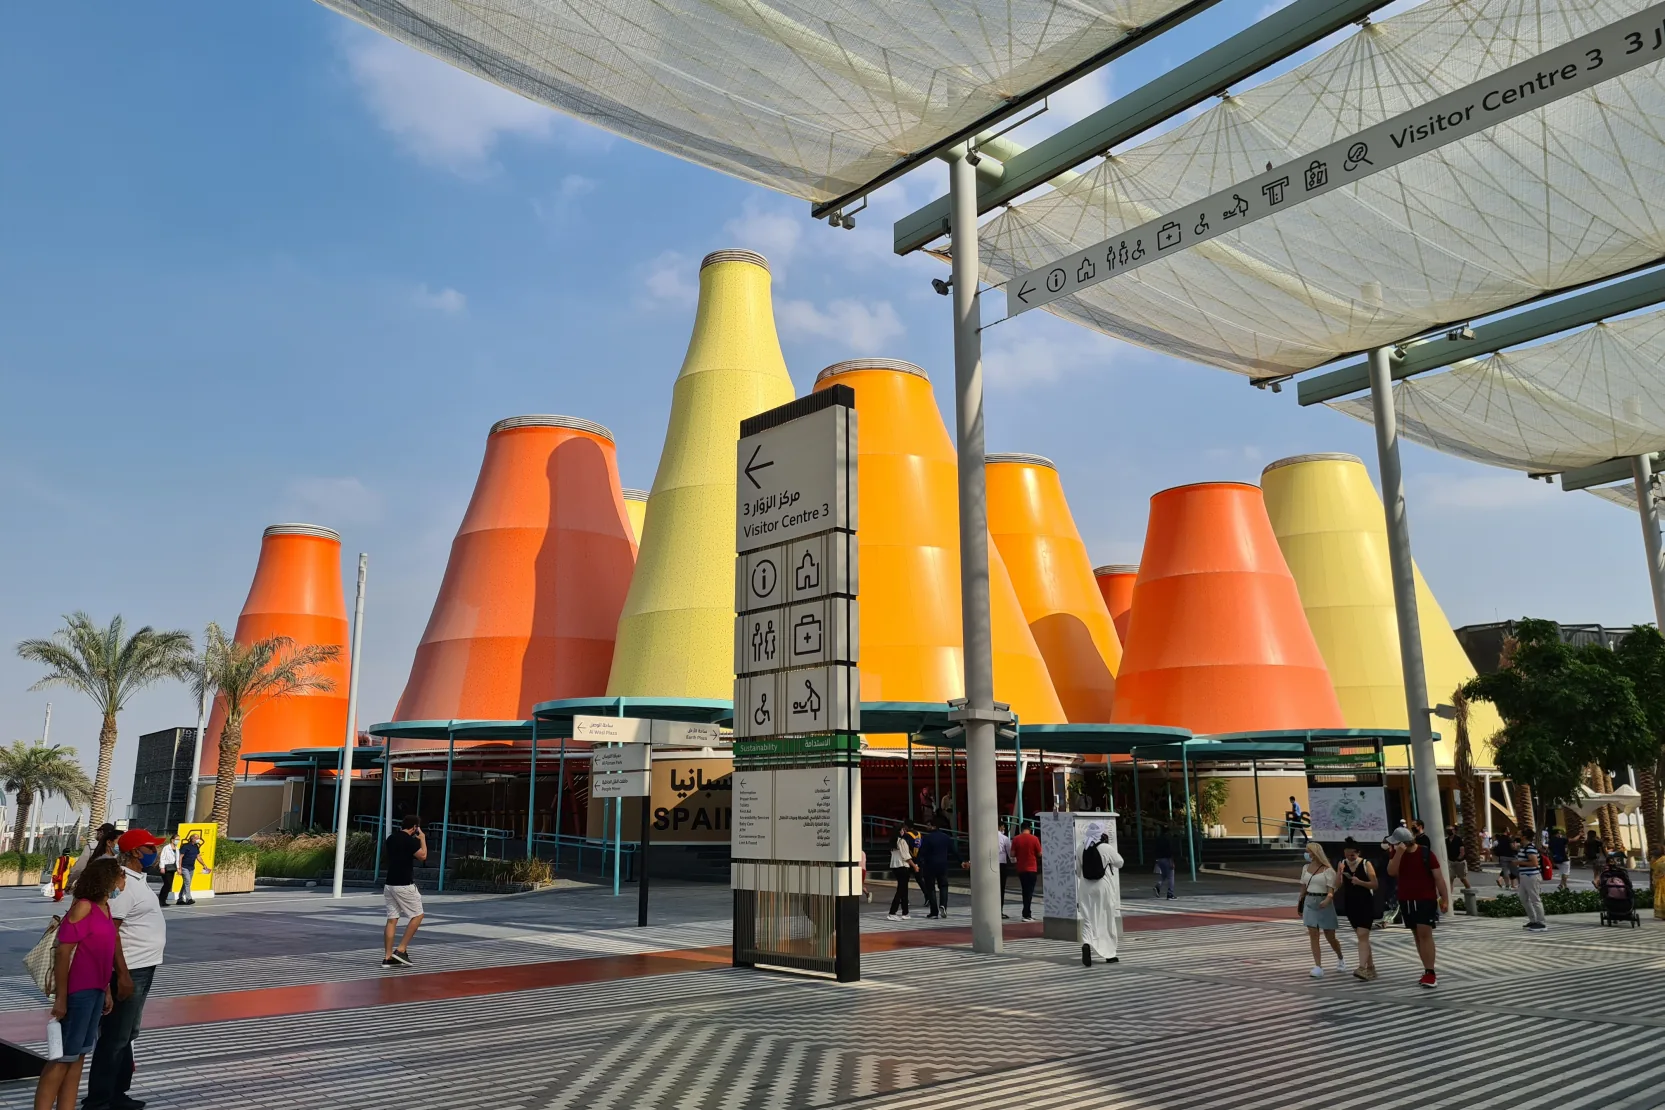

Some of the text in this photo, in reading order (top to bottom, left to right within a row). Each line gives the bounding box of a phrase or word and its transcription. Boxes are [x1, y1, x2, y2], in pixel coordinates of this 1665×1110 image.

[1624, 31, 1643, 55] 3
[1389, 48, 1604, 149] Visitor Centre 3
[743, 503, 750, 516] 3
[778, 490, 800, 510] مركز
[743, 503, 829, 538] Visitor Centre 3
[740, 743, 778, 753] Sustainability
[804, 738, 830, 748] الاستدامة
[671, 768, 732, 799] سبانيا
